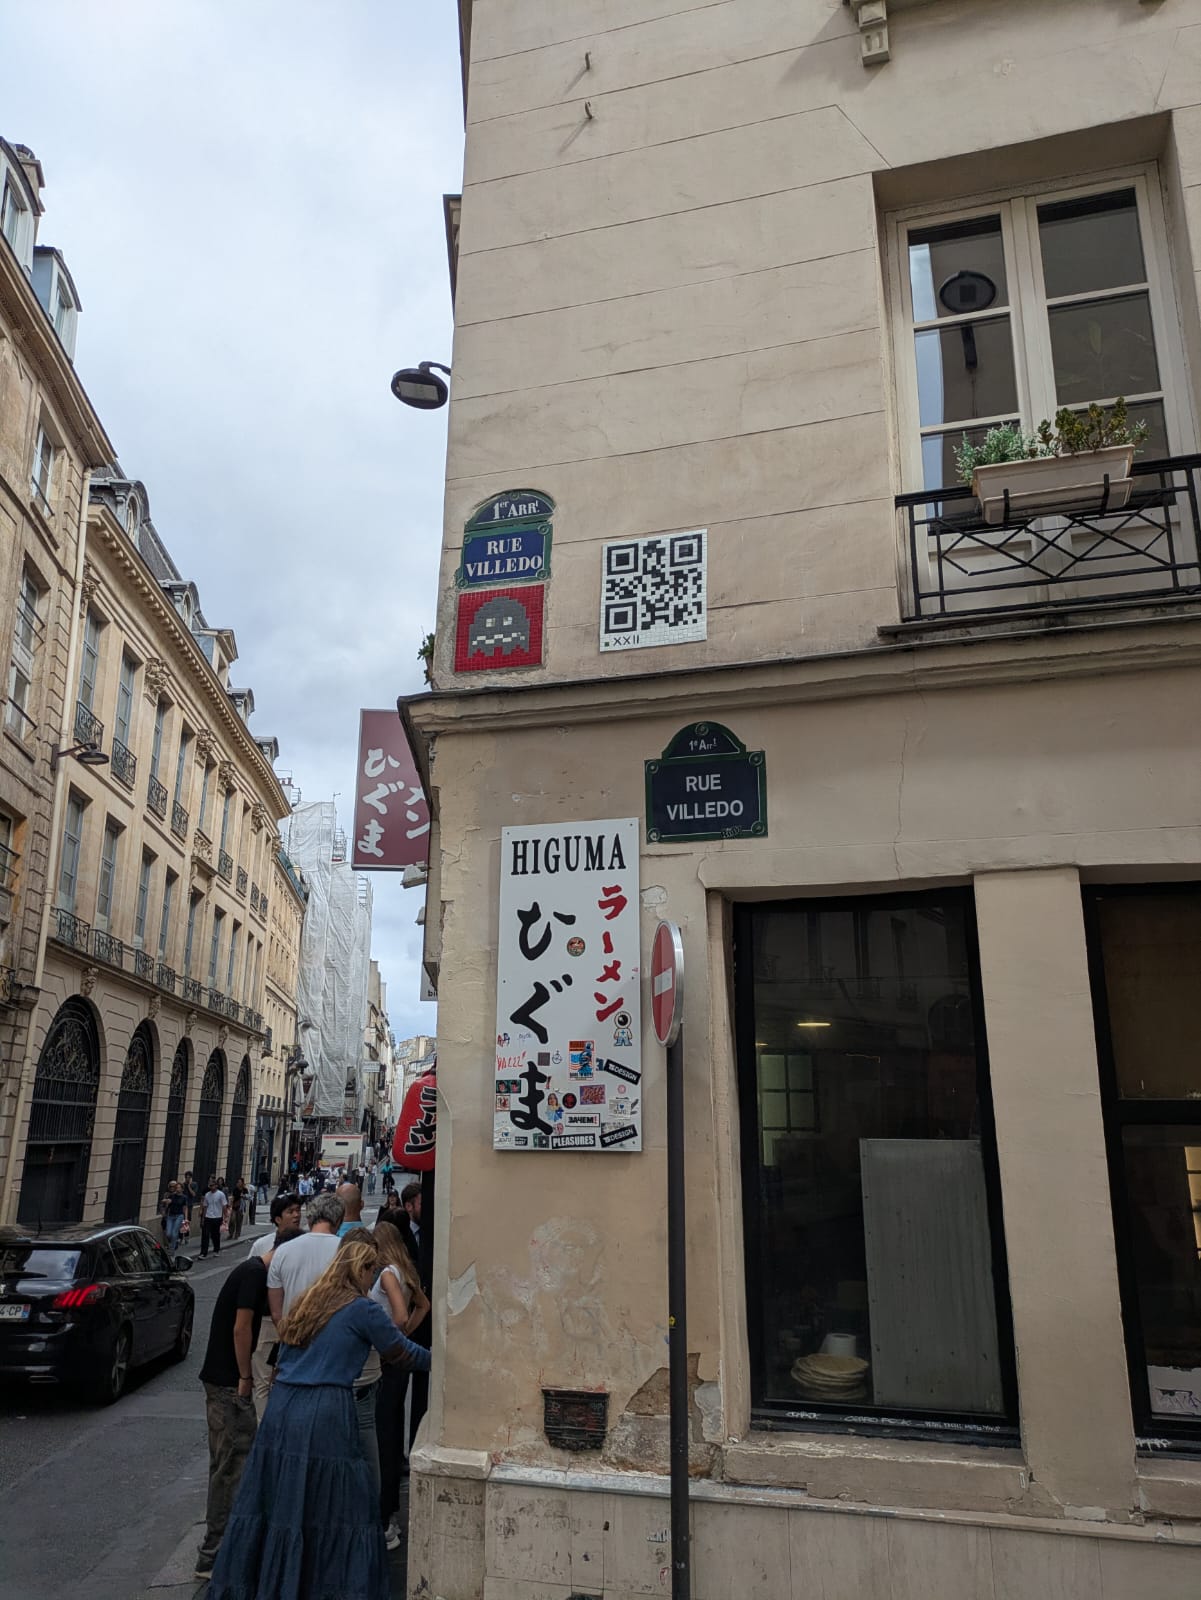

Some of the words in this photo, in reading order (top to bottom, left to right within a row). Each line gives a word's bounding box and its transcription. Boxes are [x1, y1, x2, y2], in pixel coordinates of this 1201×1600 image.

[487, 537, 522, 556] RUE
[465, 555, 543, 577] VILLEDO
[612, 634, 640, 646] XXII
[685, 773, 722, 793] RUE
[357, 748, 405, 858] ひぐま
[666, 799, 744, 821] VILLEDO
[511, 833, 627, 876] HIGUMA
[593, 884, 628, 1023] ラーメン
[509, 901, 577, 1136] ひぐま
[553, 1135, 594, 1147] PLEASURES
